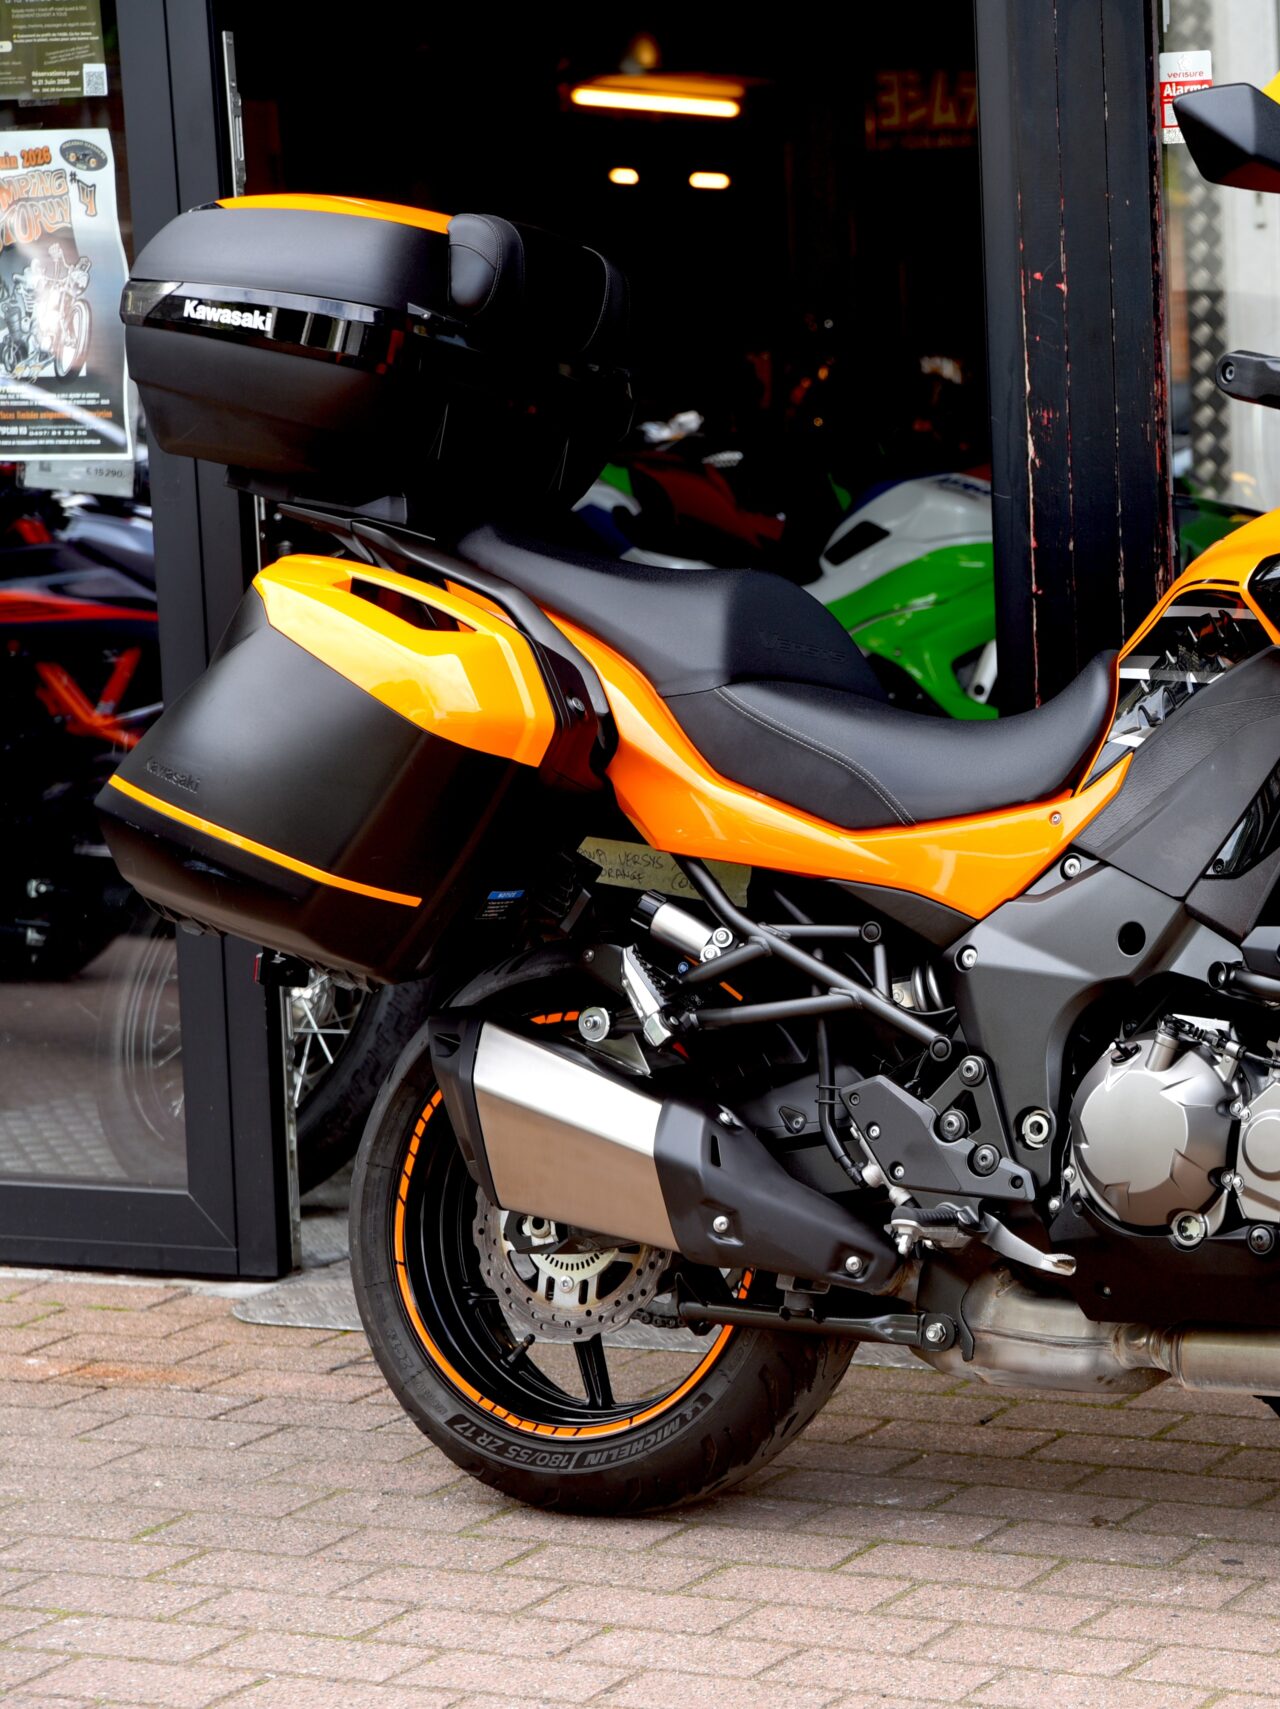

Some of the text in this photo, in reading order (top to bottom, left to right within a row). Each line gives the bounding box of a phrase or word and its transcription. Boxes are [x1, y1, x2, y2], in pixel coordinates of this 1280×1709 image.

[20, 146, 51, 169] 2026
[183, 298, 273, 332] Kawasaki
[618, 852, 665, 870] VERSYS
[600, 867, 647, 884] ORANGE
[453, 1419, 681, 1468] MICHELIN 180/55 ZR 17
